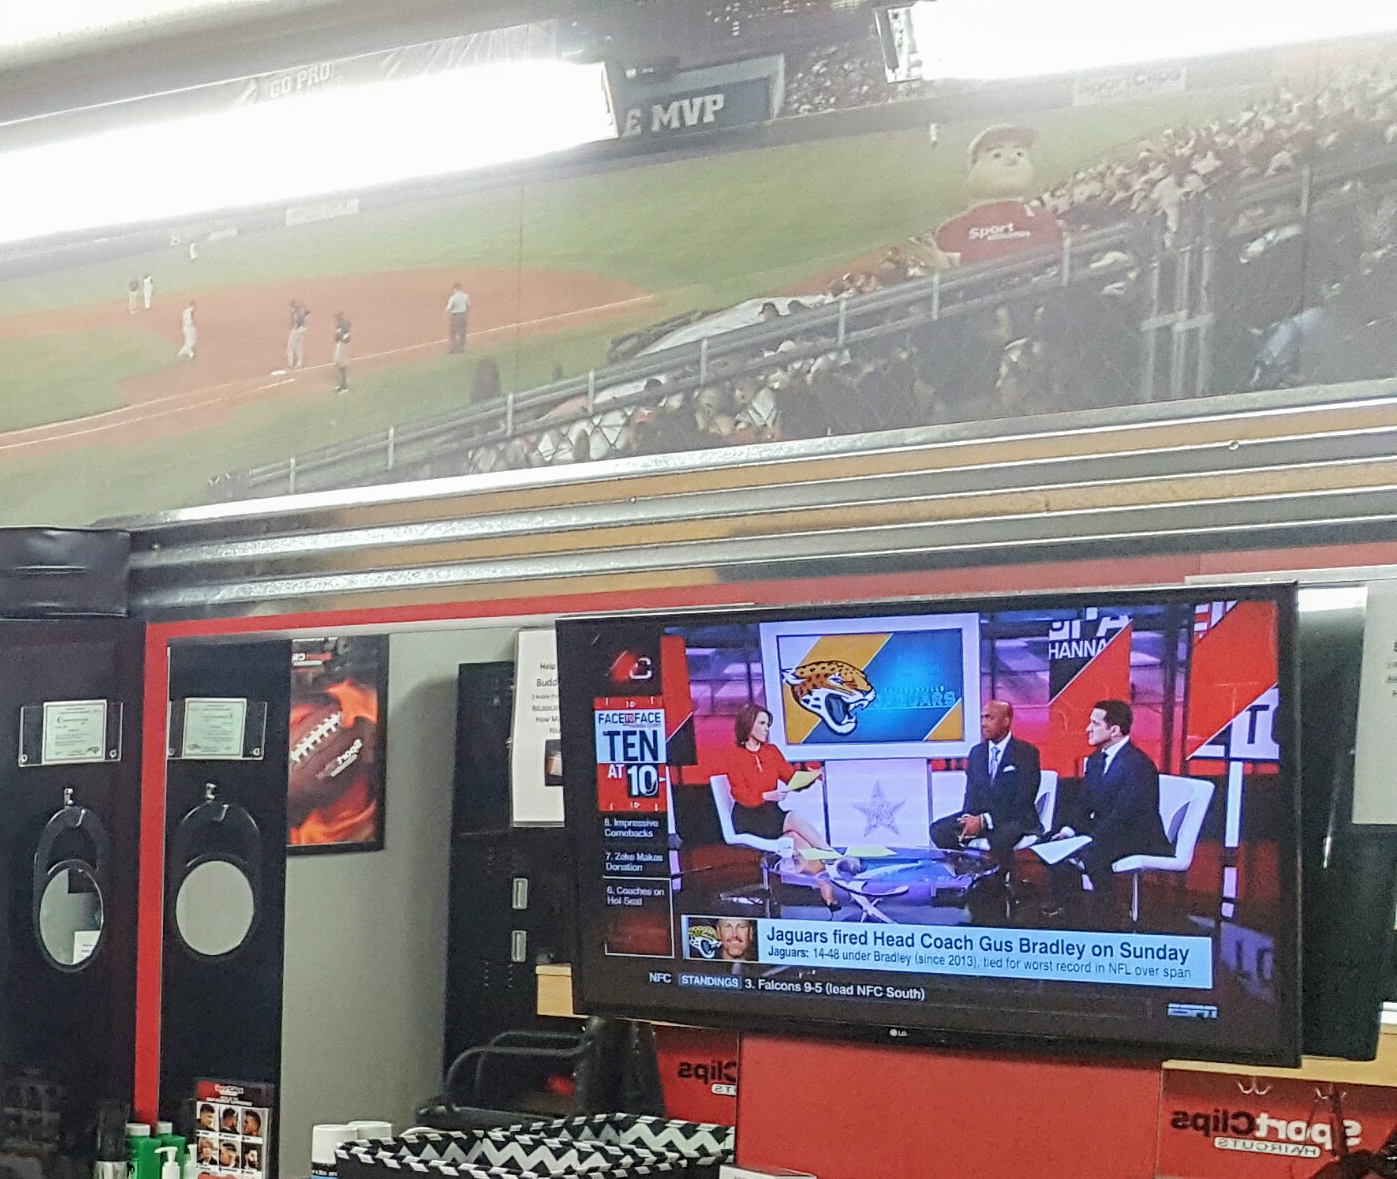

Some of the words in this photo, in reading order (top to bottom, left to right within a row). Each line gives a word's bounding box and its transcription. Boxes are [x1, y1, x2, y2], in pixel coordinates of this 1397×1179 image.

[651, 93, 725, 132] MVP
[968, 222, 1014, 240] Sport
[603, 730, 659, 762] TEN
[608, 764, 625, 779] AT
[627, 764, 659, 796] 10
[604, 829, 654, 838] Comebacks
[606, 863, 644, 872] Donation
[616, 887, 651, 896] Coaches
[767, 926, 828, 946] Jaguars
[833, 928, 869, 947] fired
[873, 931, 917, 949] Head
[920, 932, 974, 951] Coach
[979, 935, 1013, 953] Gus
[1019, 938, 1086, 960] Bradley
[1092, 943, 1114, 958] on
[1119, 942, 1190, 966] Sunday
[768, 945, 810, 959] Jaguars:
[813, 948, 840, 961] 14-48
[842, 950, 872, 963] under
[874, 951, 912, 967] Bradley
[915, 952, 945, 967] (since
[983, 957, 1003, 970] tied
[1006, 958, 1022, 971] for
[1023, 960, 1054, 973] worst
[1056, 961, 1092, 974] record
[1095, 962, 1106, 974] in
[1108, 963, 1132, 976] NFL
[1134, 966, 1160, 978] over
[1163, 967, 1193, 980] span
[649, 972, 673, 985] NFC
[681, 975, 740, 989] STANDINGS
[744, 978, 756, 990] 3.
[758, 980, 802, 993] Falcons
[804, 982, 823, 994] 9-5
[825, 983, 854, 996] (lead
[856, 985, 884, 998] NFC
[886, 986, 926, 1001] South)
